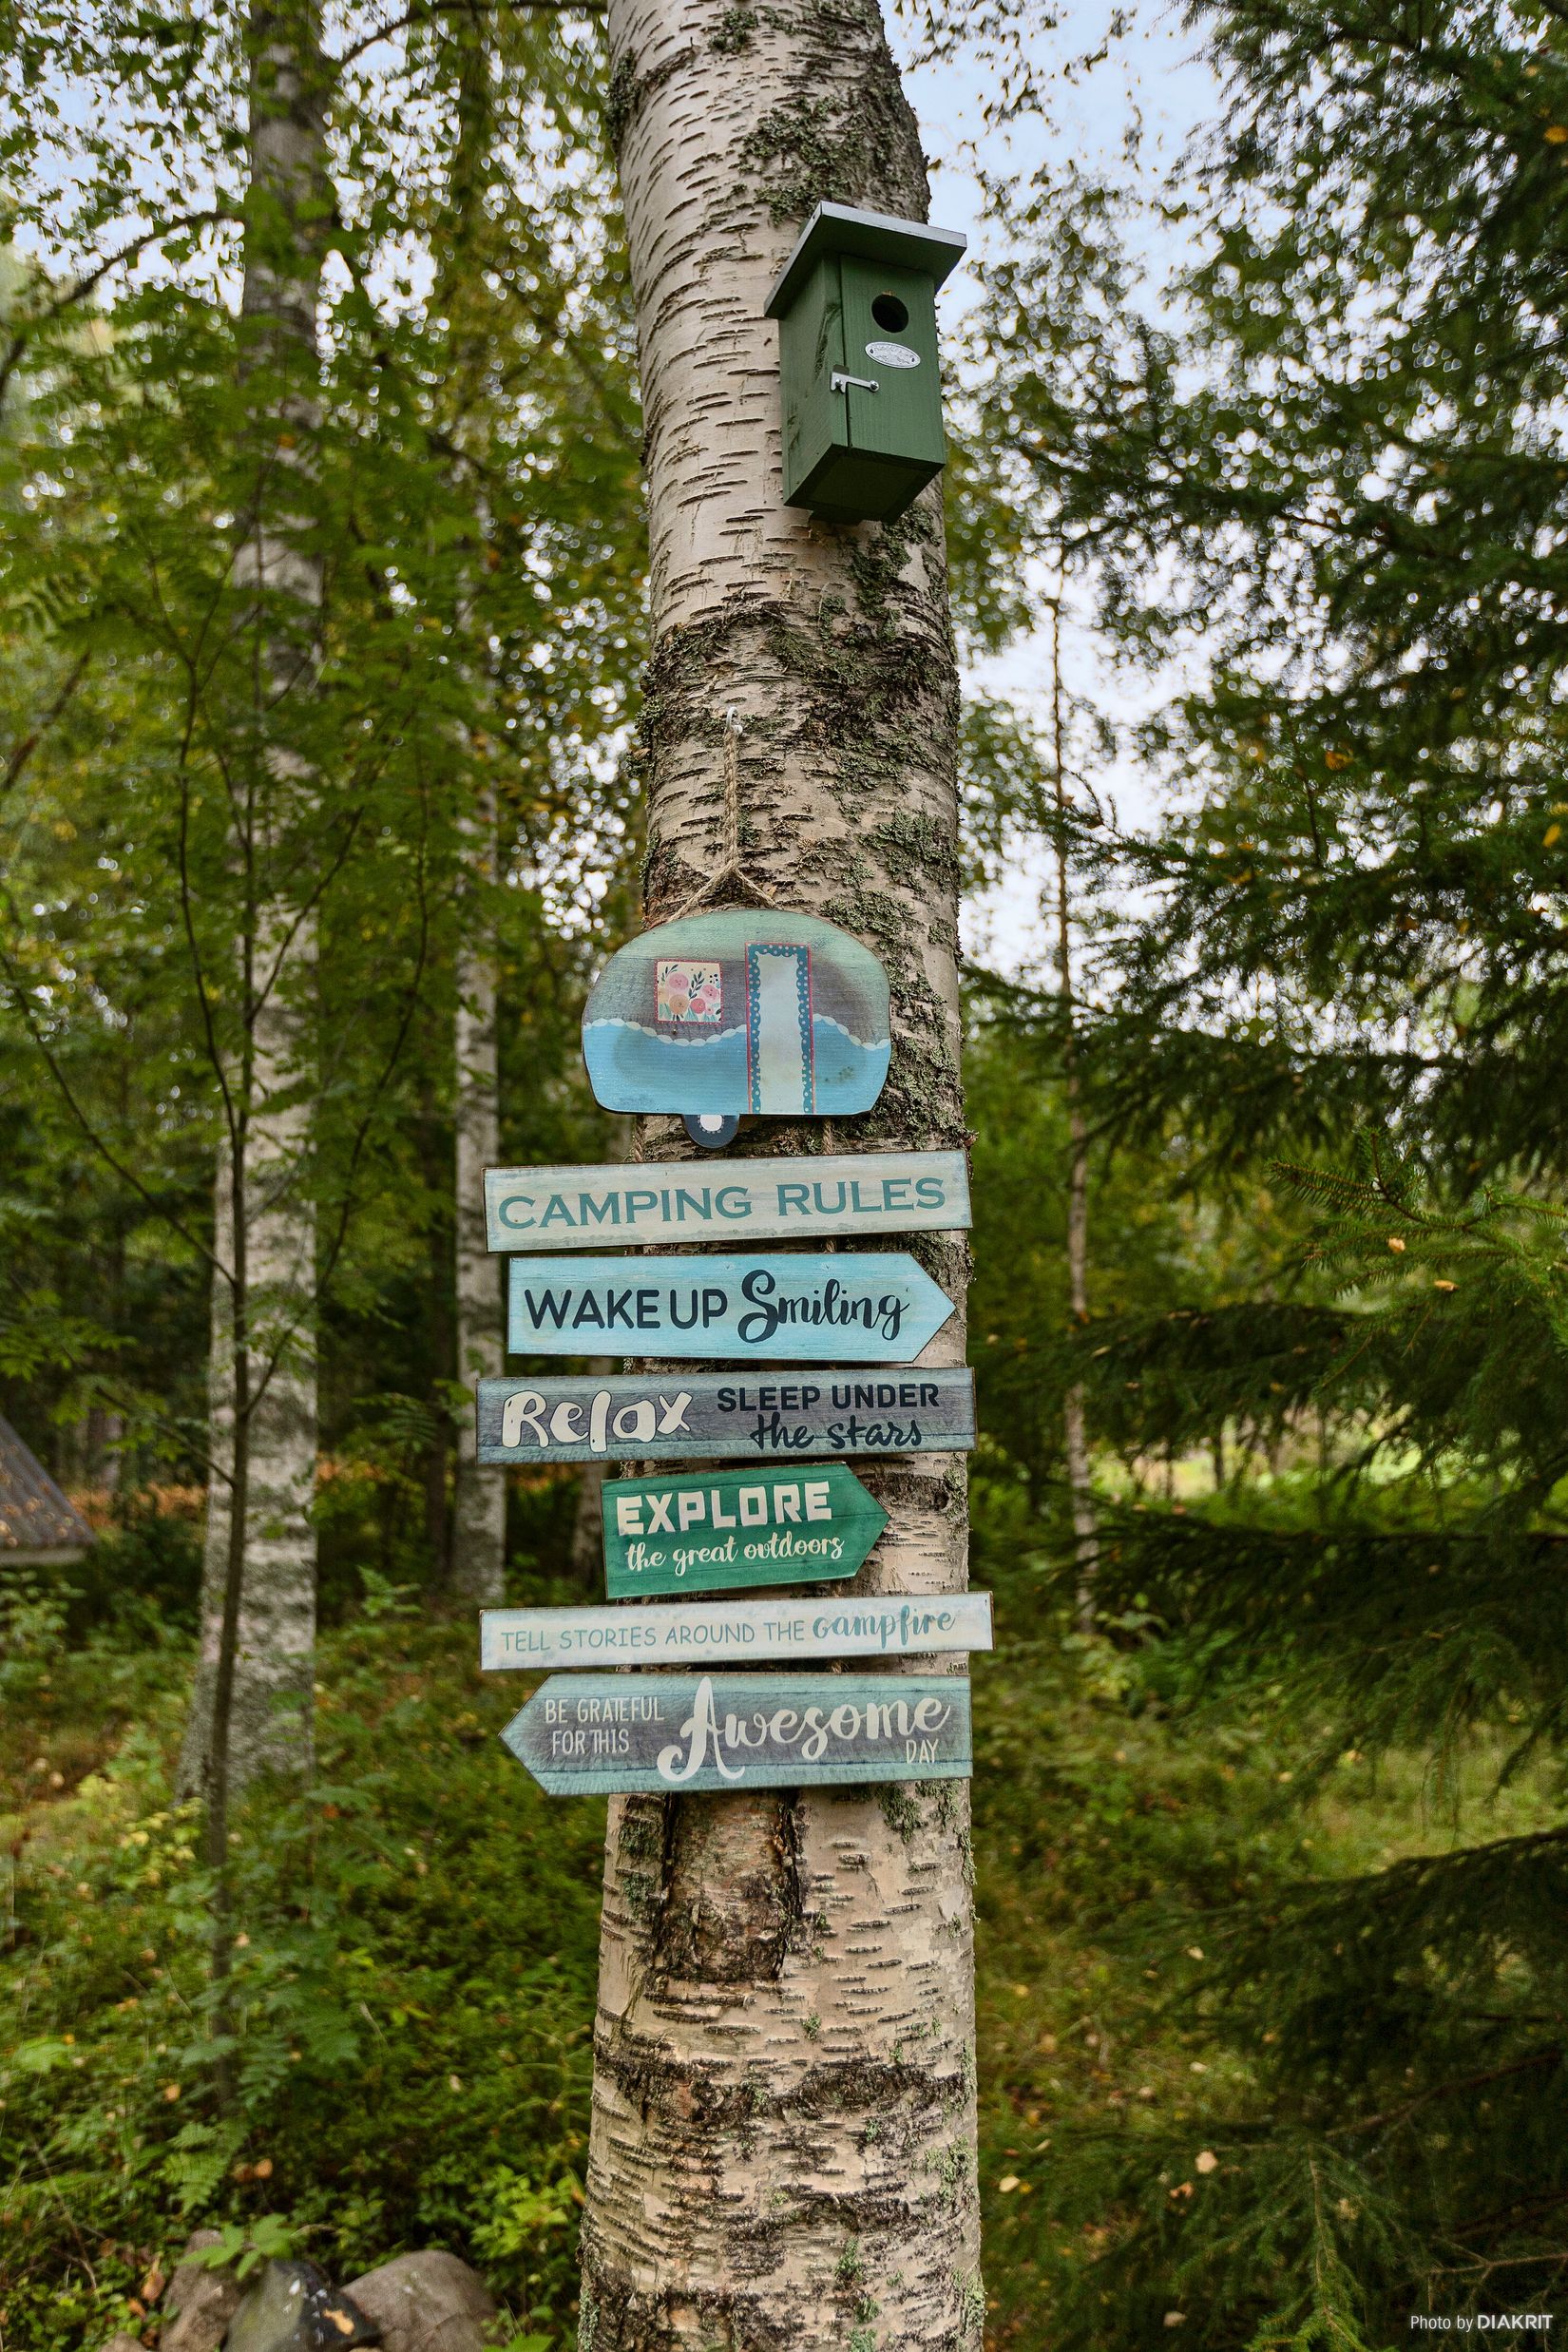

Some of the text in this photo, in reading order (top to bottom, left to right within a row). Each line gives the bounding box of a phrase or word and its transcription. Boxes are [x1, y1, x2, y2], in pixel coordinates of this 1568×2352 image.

[498, 1176, 947, 1230] CAMPING RULES
[524, 1270, 910, 1343] WAKE UP Smiling
[502, 1389, 694, 1452] Relax
[717, 1383, 940, 1412] SLEEP UNDER
[751, 1411, 923, 1449] the stars
[616, 1481, 832, 1536] EXPLORE
[624, 1530, 845, 1577] the great outdoors
[501, 1604, 956, 1652] TELL STORIES AROUND THE campfire
[545, 1696, 664, 1723] BE GRATEFUL
[657, 1675, 950, 1782] Awesome
[551, 1729, 629, 1754] FOR THIS
[906, 1739, 938, 1764] DAY
